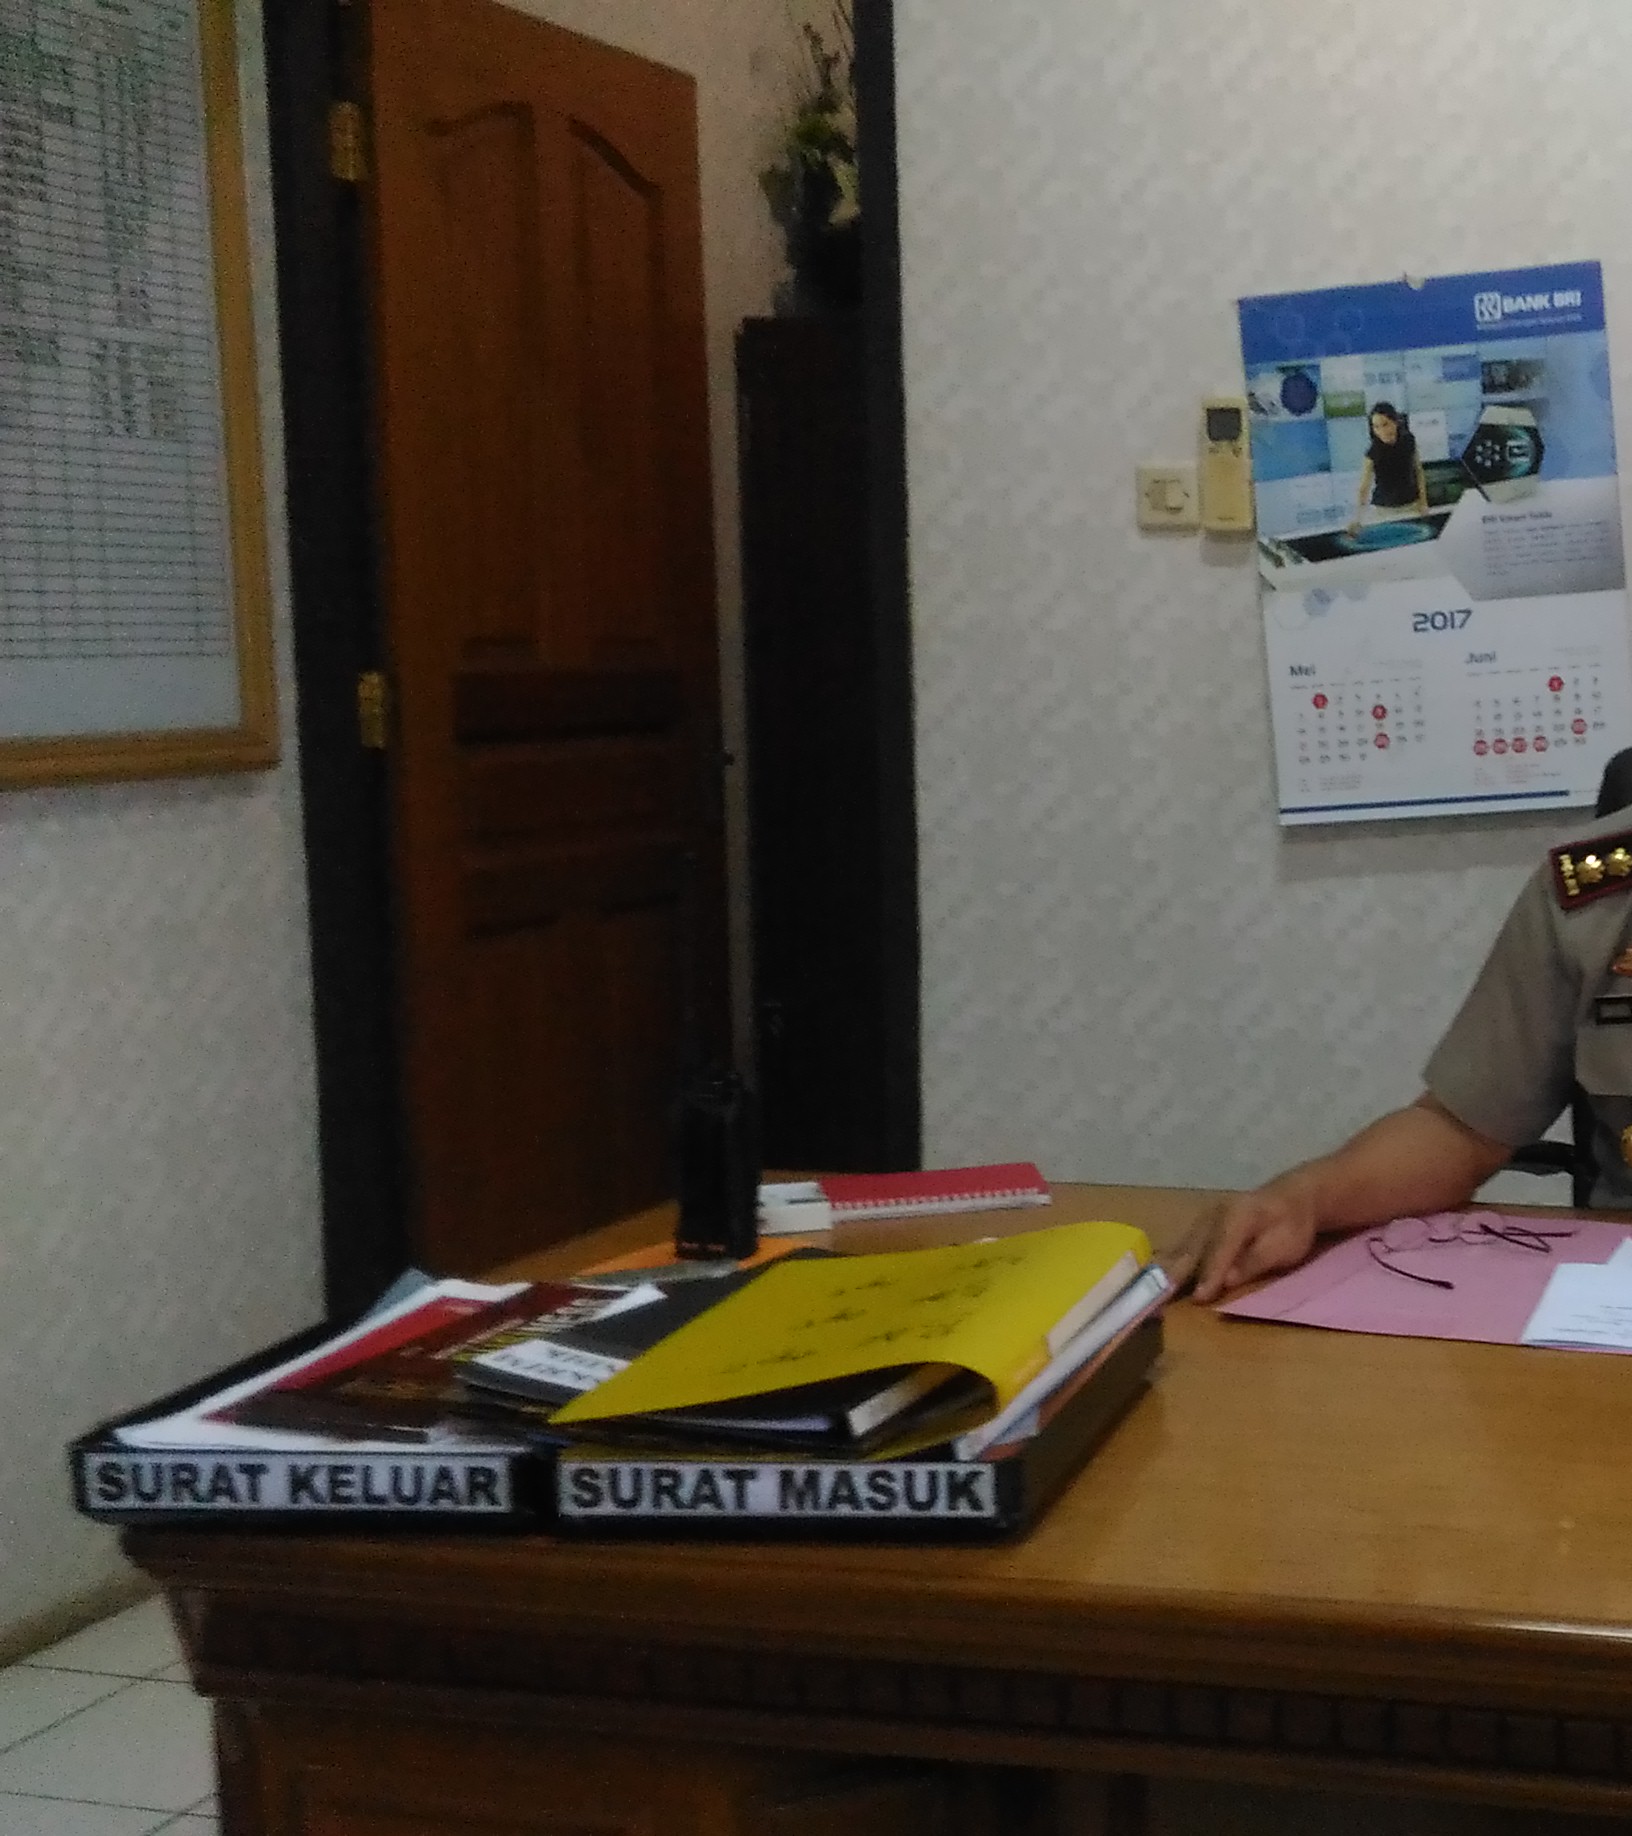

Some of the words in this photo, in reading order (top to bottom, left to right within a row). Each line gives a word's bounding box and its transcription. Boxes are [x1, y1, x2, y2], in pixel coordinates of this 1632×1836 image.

[1502, 294, 1550, 313] BANK
[1553, 290, 1581, 308] BRI
[1412, 608, 1473, 632] 2017
[1464, 651, 1497, 664] Juni
[1289, 664, 1316, 677] Mei
[98, 1461, 268, 1502] SURAT
[287, 1463, 498, 1506] KELUAR
[570, 1467, 756, 1510] SURAT
[779, 1469, 986, 1512] MASUK
